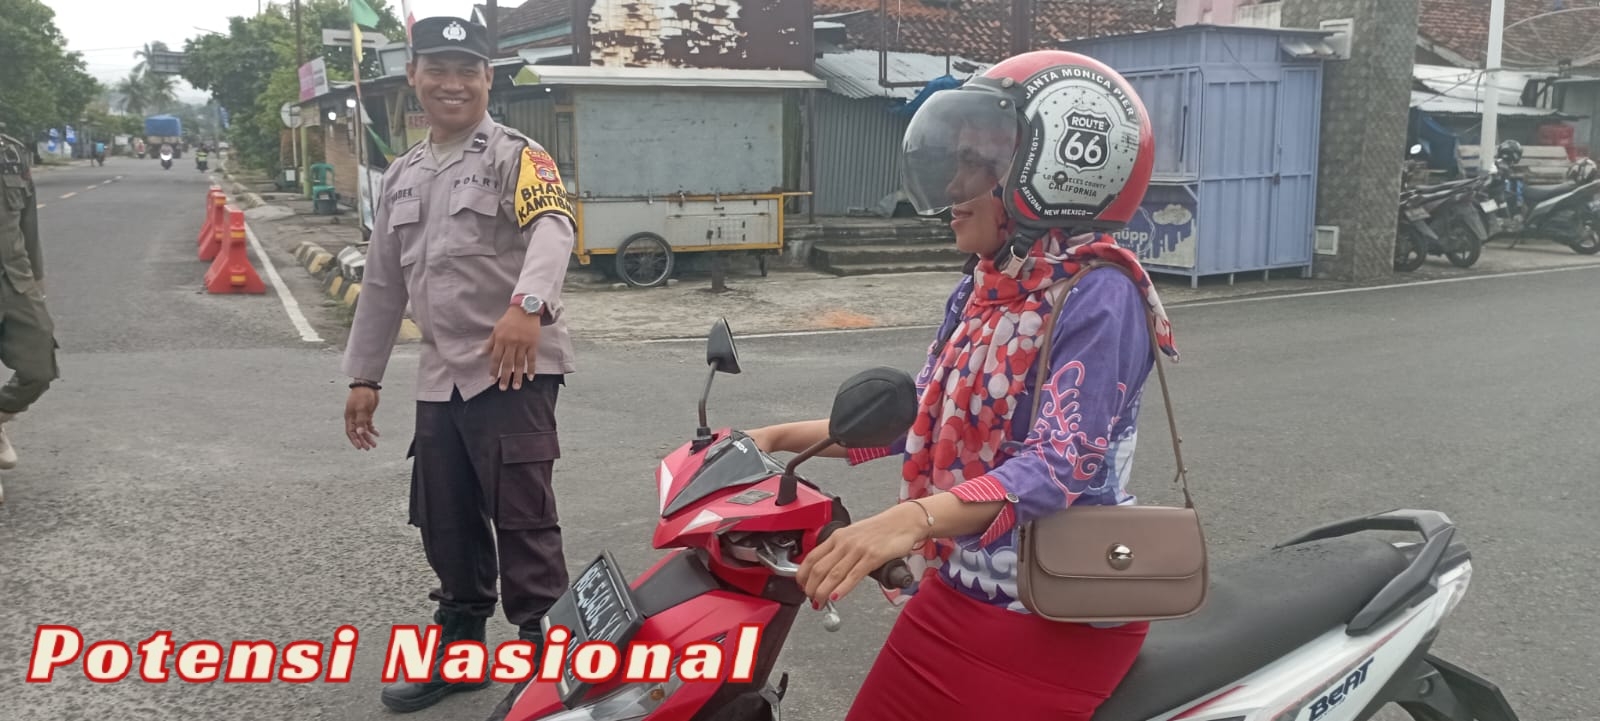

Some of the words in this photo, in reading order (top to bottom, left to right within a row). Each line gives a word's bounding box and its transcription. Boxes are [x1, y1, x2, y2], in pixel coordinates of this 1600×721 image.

[1061, 68, 1112, 89] MONICA
[1112, 86, 1134, 116] PIER
[1071, 115, 1105, 131] ROUTE
[1030, 136, 1039, 152] LOS
[1064, 131, 1102, 164] 66
[1019, 152, 1036, 184] ANGELES
[453, 174, 499, 189] POLRI
[1084, 180, 1107, 189] COUNTY
[1048, 183, 1097, 197] CALIFORNIA
[1022, 185, 1043, 212] ARIZONA
[1044, 208, 1060, 216] NEW
